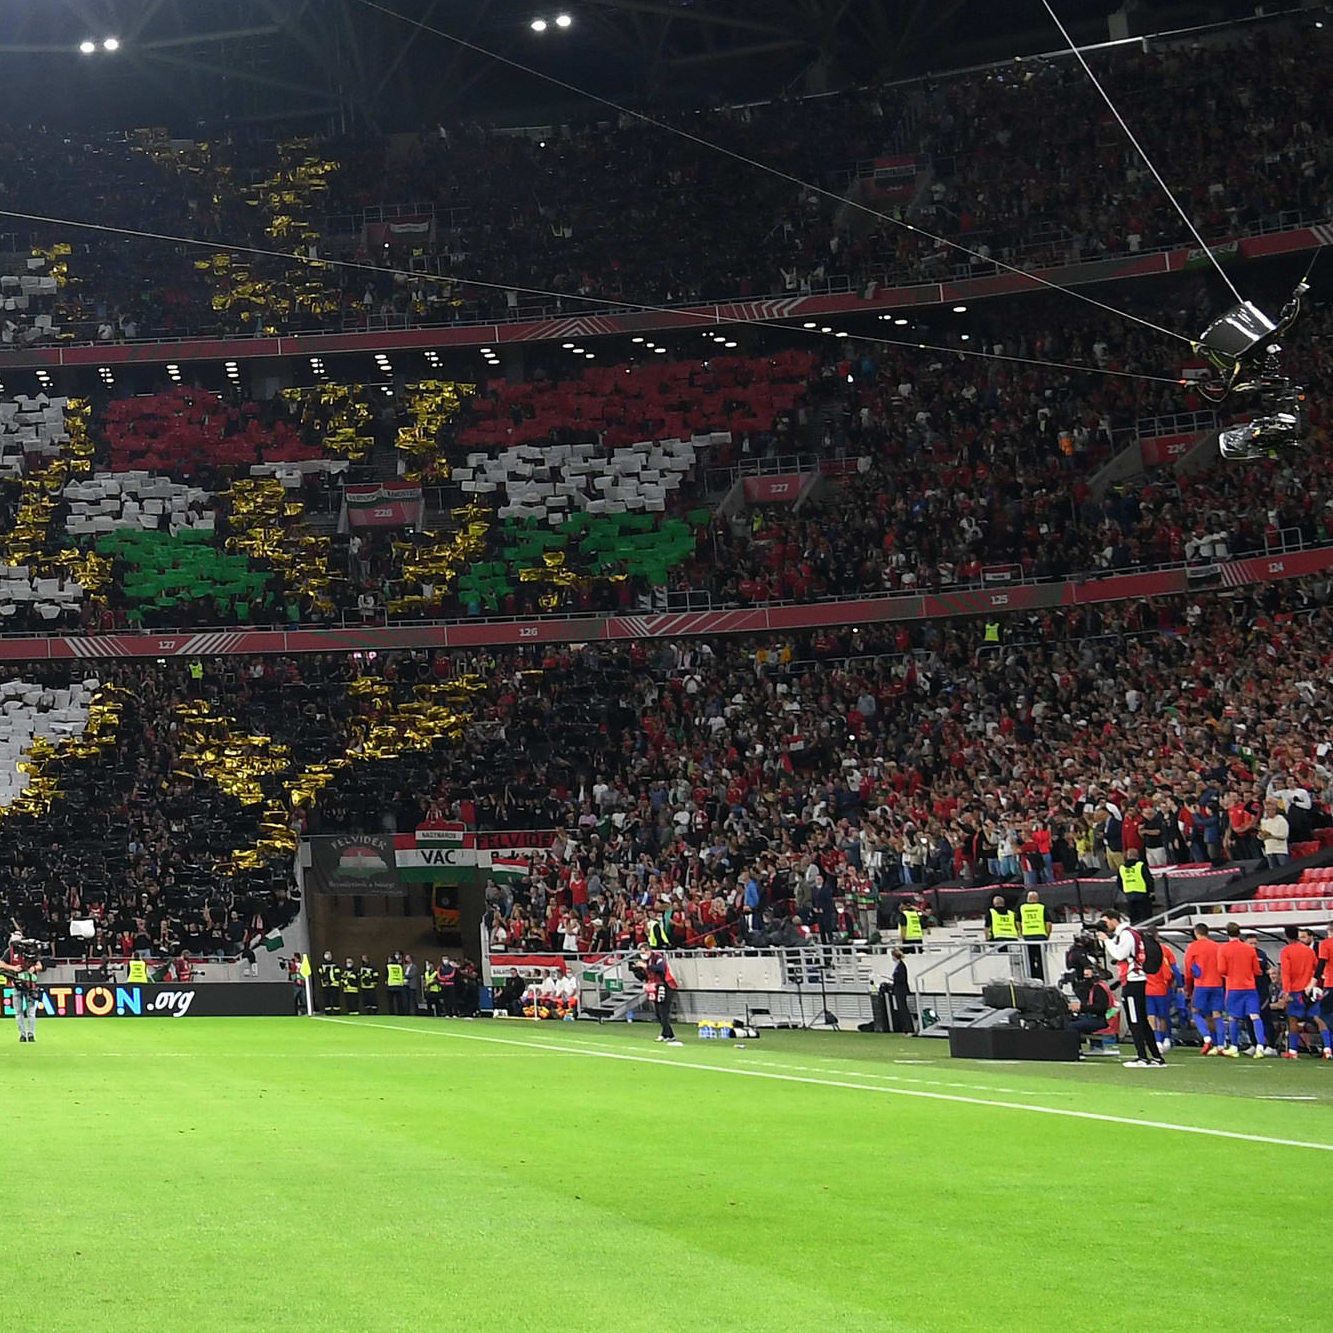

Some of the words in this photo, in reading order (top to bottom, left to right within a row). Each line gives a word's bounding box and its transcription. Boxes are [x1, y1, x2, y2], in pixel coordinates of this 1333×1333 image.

[990, 595, 1008, 605] 125
[519, 628, 537, 636] 126
[158, 641, 176, 649] 127
